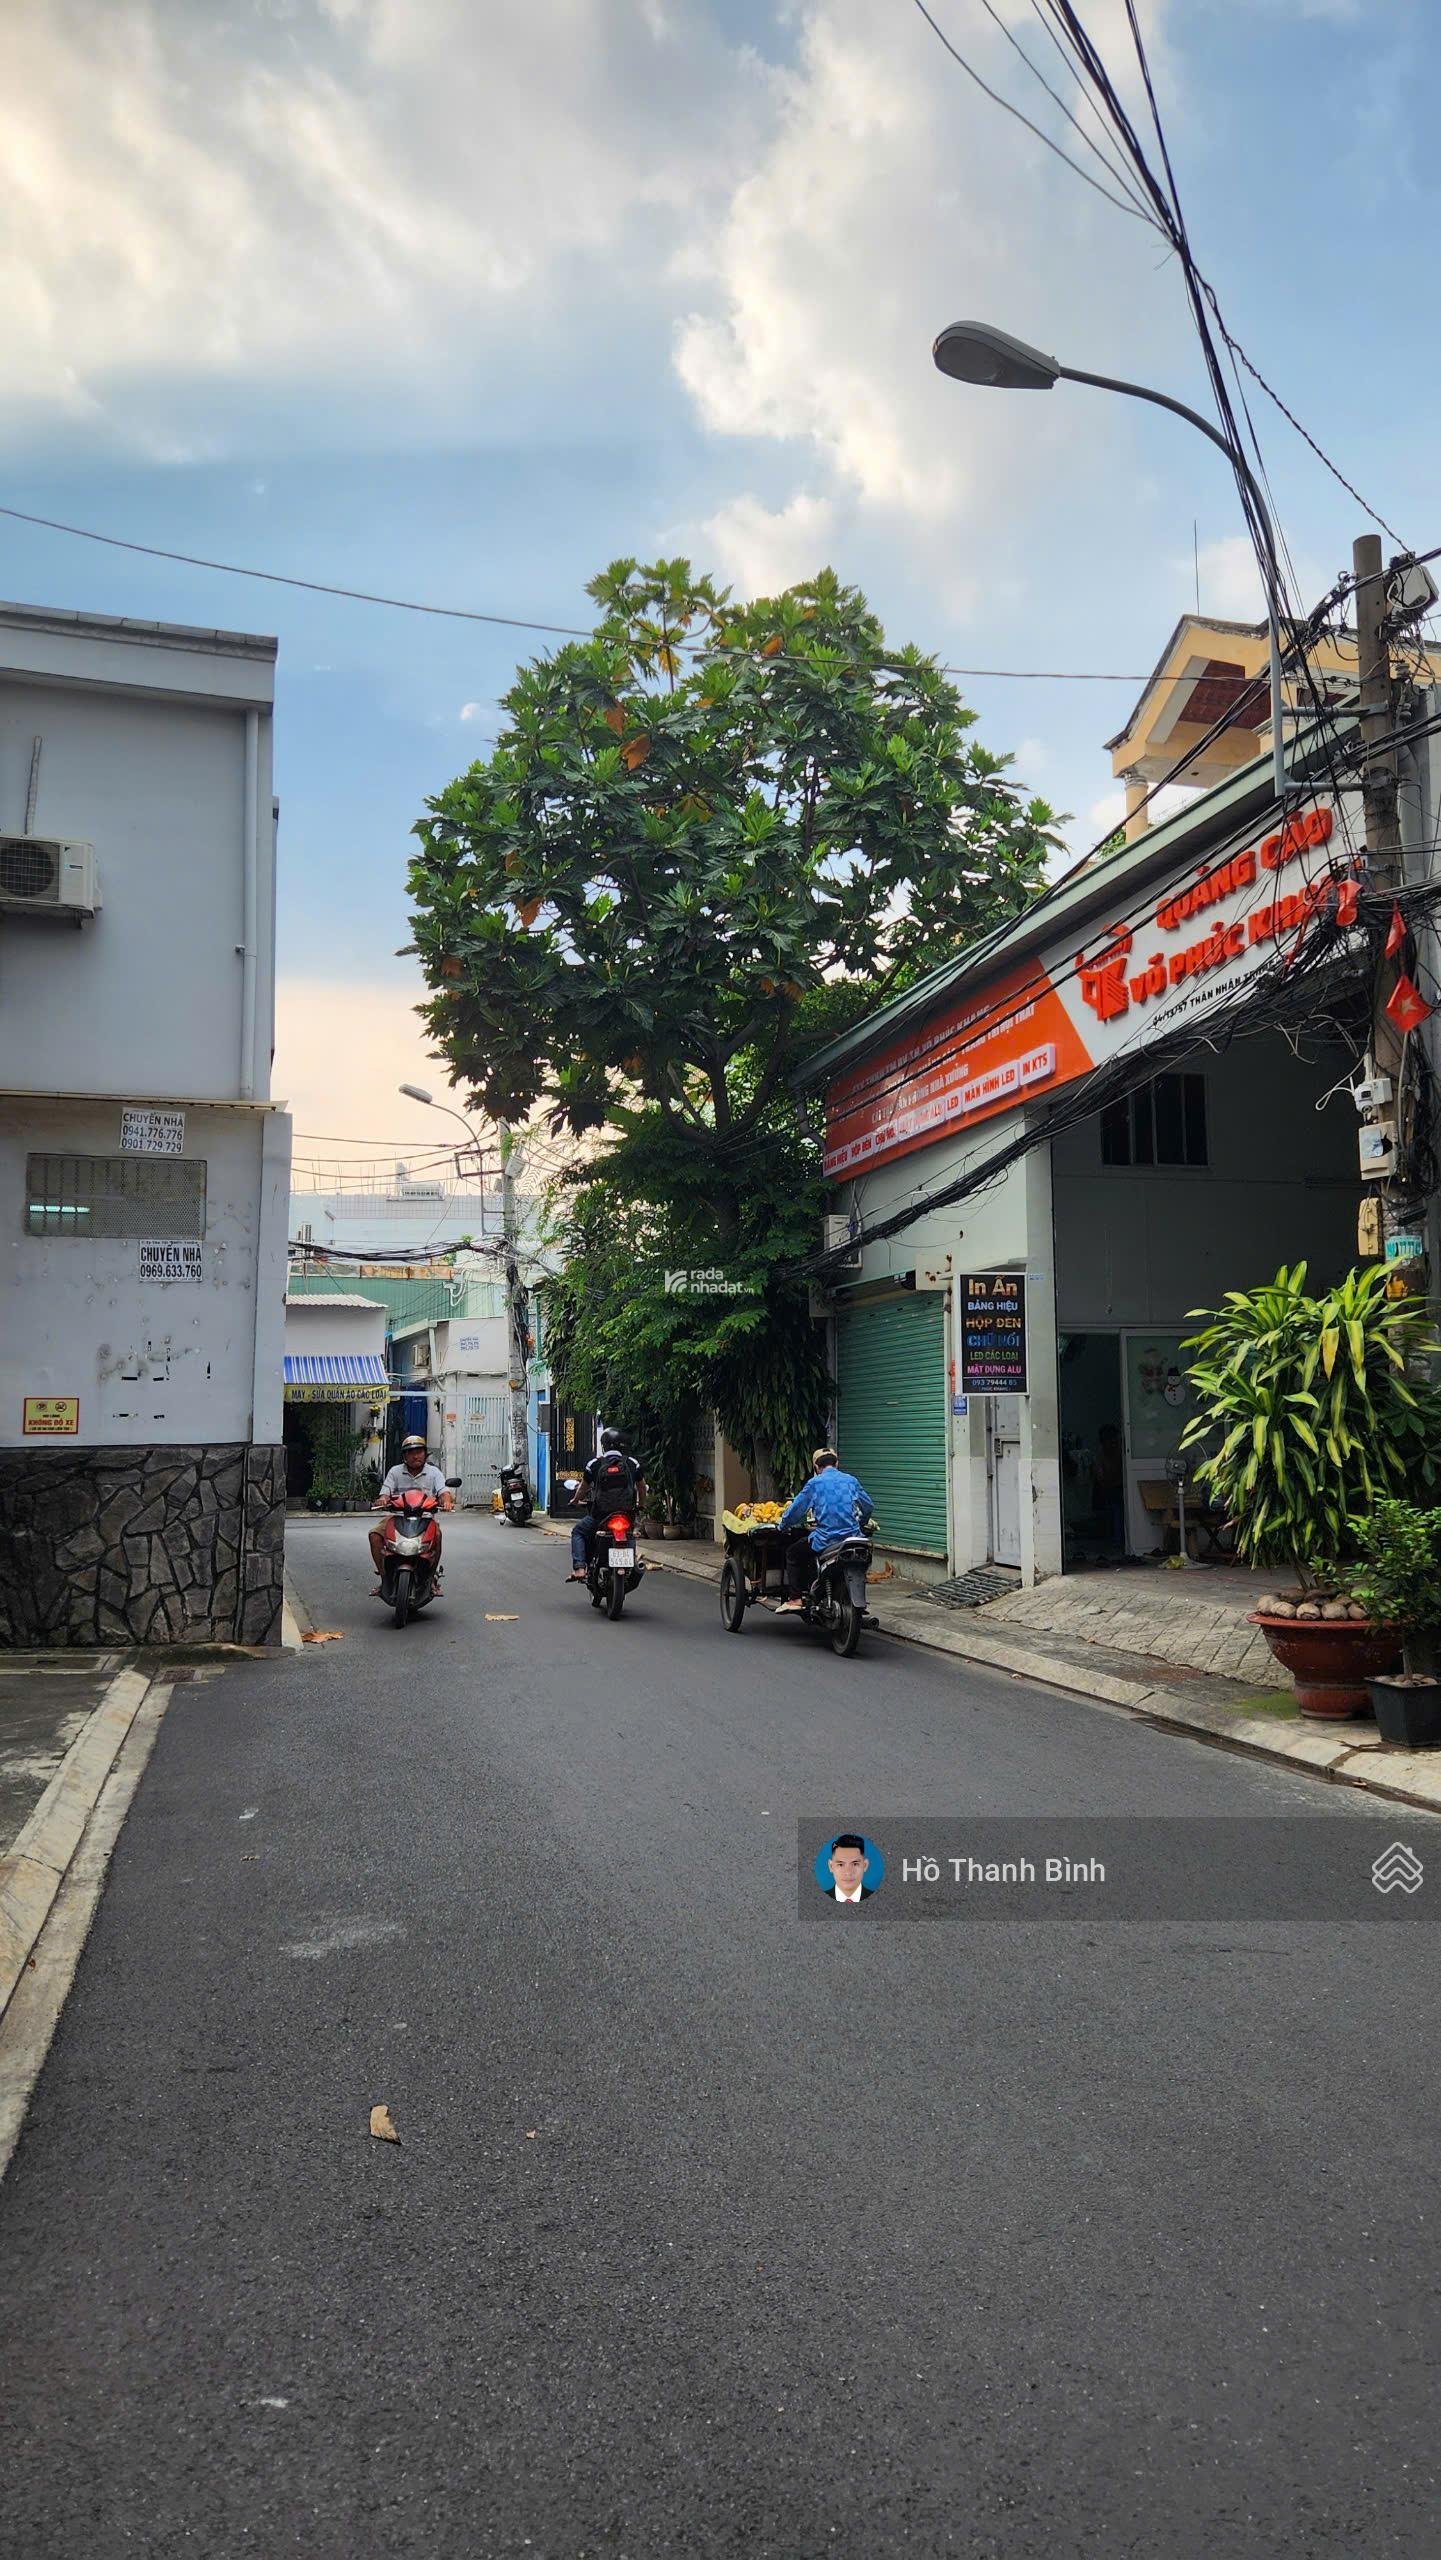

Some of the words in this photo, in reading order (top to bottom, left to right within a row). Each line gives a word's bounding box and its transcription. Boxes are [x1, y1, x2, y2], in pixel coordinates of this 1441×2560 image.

[1157, 851, 1256, 929] QUẢNG
[1261, 808, 1332, 870] CÁO
[1169, 922, 1245, 984] PHÚC
[1023, 1061, 1031, 1076] IN
[1032, 1053, 1048, 1073] KTS
[964, 1084, 980, 1103] MÀN
[982, 1077, 1000, 1094] HÌNH
[1001, 1069, 1015, 1086] LED
[946, 1096, 959, 1111] LED
[122, 1125, 183, 1141] 0941.776.776
[183, 1244, 202, 1262] NHÀ
[140, 1264, 202, 1278] 0969.633.760
[968, 1278, 987, 1296] In
[967, 1299, 994, 1311] BẢNG
[996, 1300, 1019, 1313] HIỆU
[970, 1351, 984, 1360] LED
[985, 1350, 1000, 1360] CÁC
[1002, 1351, 1019, 1362] LOẠI
[1007, 1365, 1021, 1374] ALU
[292, 1389, 305, 1400] MAY
